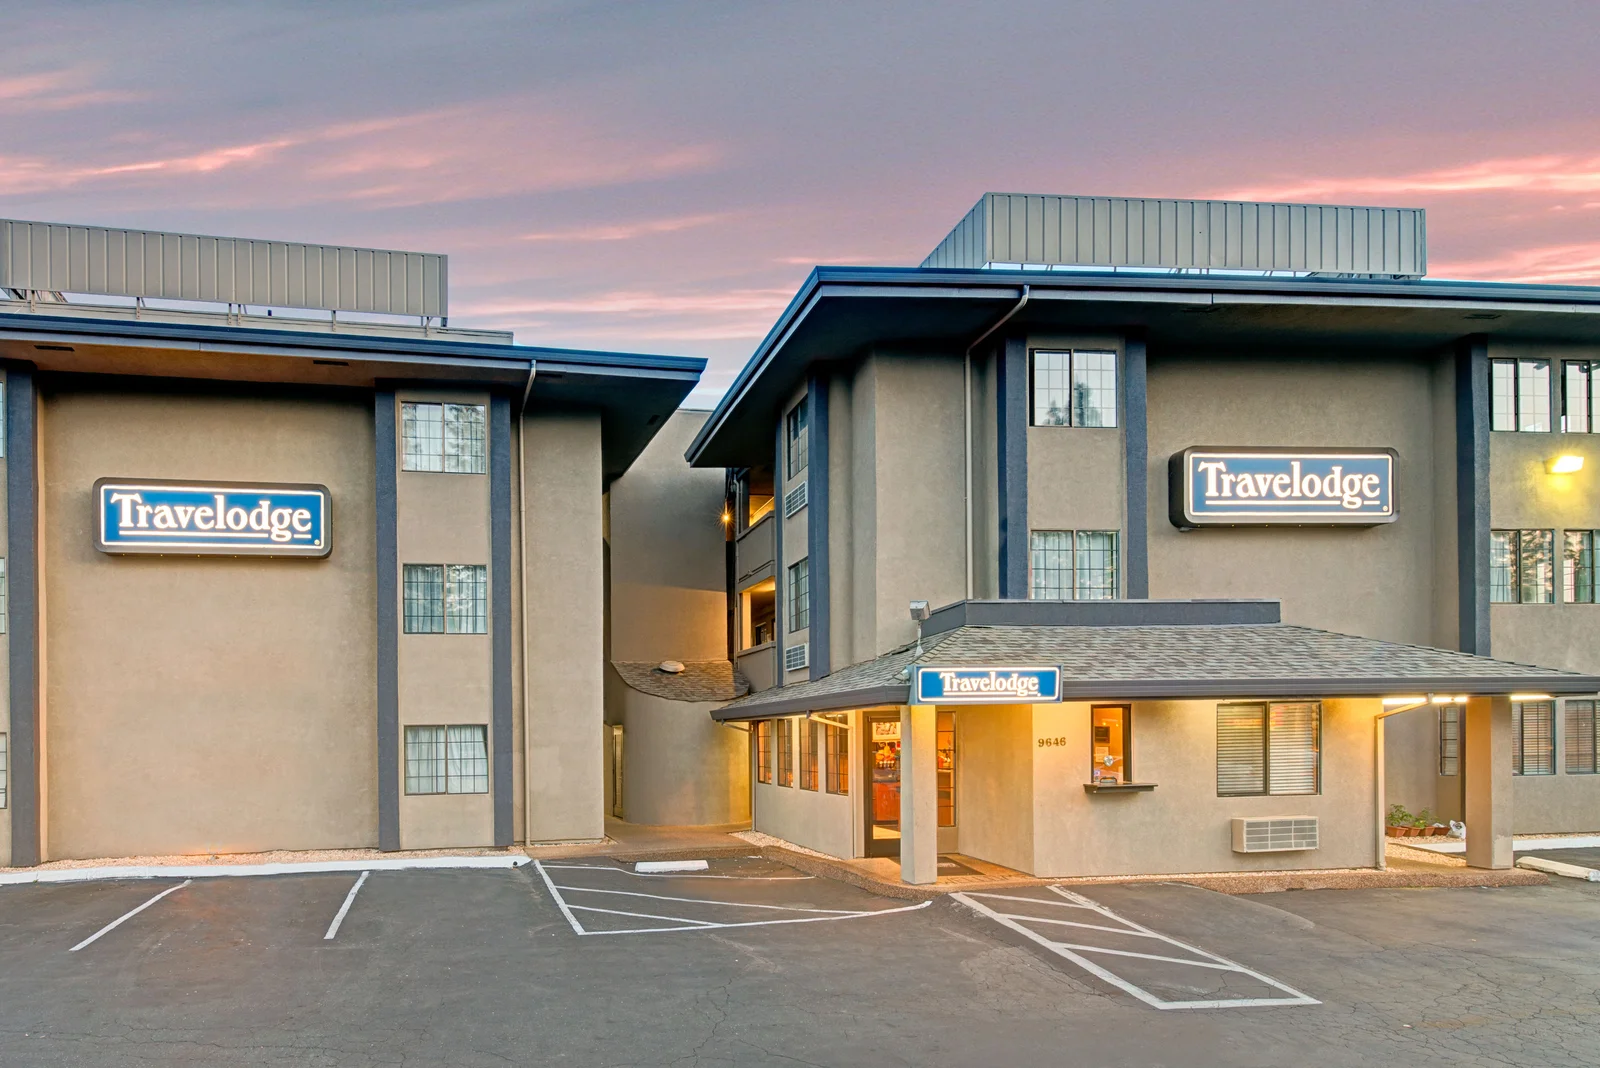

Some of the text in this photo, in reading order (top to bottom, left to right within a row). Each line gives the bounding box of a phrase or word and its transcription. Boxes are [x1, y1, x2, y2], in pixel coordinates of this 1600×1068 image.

[1198, 461, 1380, 509] Travelodge
[110, 492, 312, 542] Travelodge
[939, 671, 1039, 697] Travelodge
[1038, 737, 1067, 748] 9646
